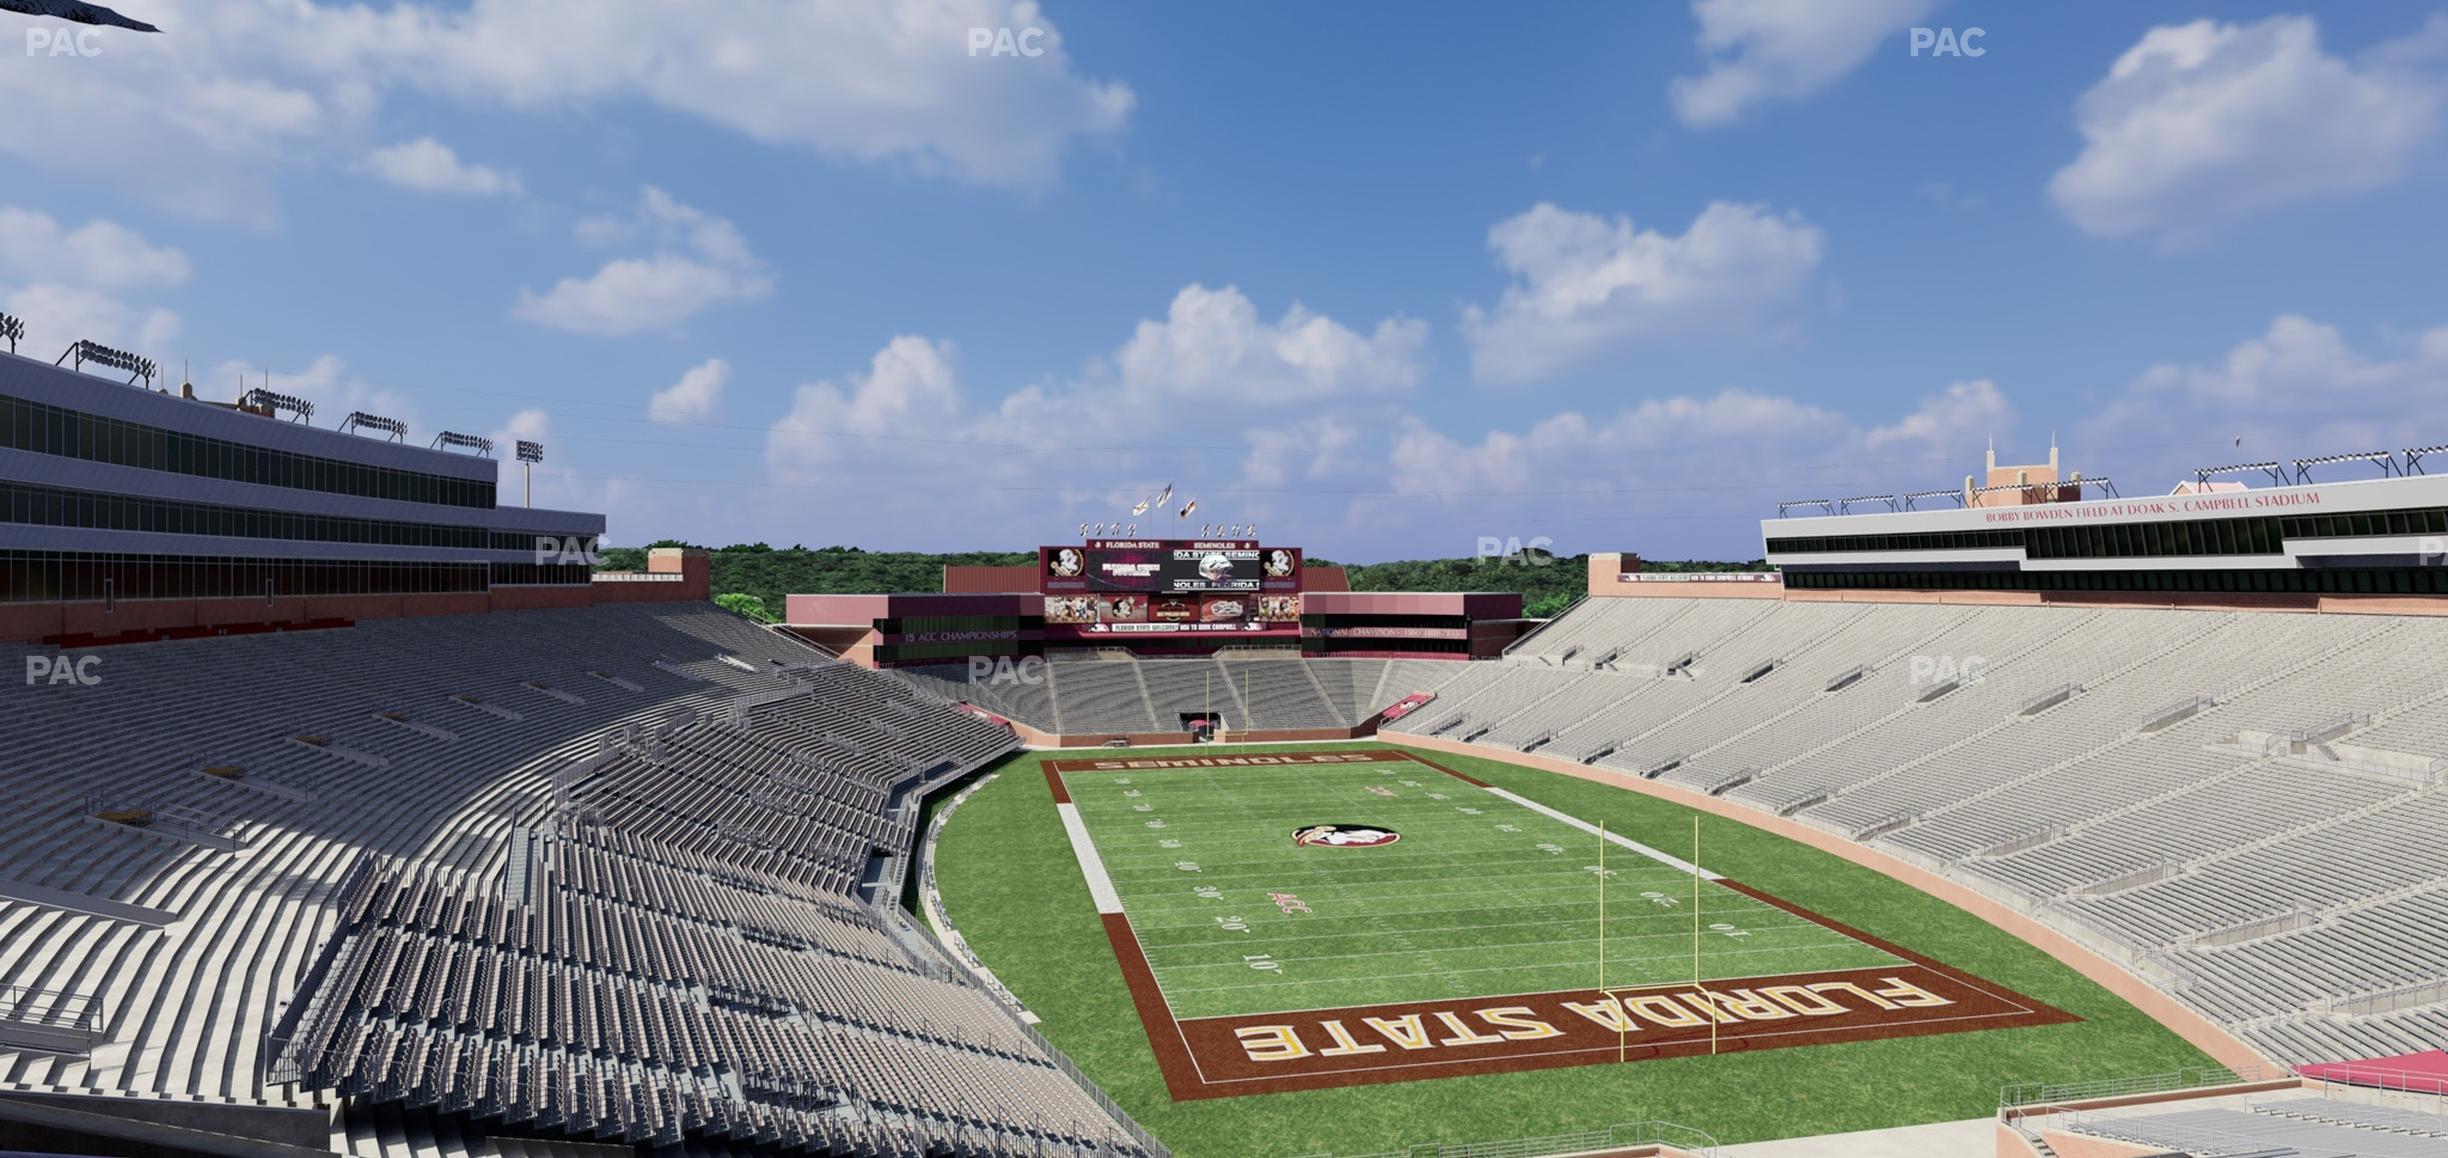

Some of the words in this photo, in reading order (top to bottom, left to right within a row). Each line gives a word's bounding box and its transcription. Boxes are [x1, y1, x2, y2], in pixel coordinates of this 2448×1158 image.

[1986, 511, 2021, 523] BOBBY
[2127, 501, 2165, 515] DOAK
[2184, 497, 2252, 512] CAMPBELL
[2254, 492, 2321, 507] STADIUM
[1105, 541, 1137, 549] FLORIDA
[1138, 541, 1160, 549] STATE
[1193, 541, 1236, 549] SEMINOLES
[919, 632, 936, 641] ACC
[940, 630, 1017, 641] CHAMPIONSHIPS
[1094, 754, 1373, 769] SEMINOLES
[1266, 892, 1312, 913] ACC
[1216, 915, 1248, 931] 20
[1708, 923, 1752, 943] 10
[1242, 953, 1280, 971] 10
[1561, 977, 1956, 1033] FLORIDA
[1233, 1007, 1567, 1062] STATE
